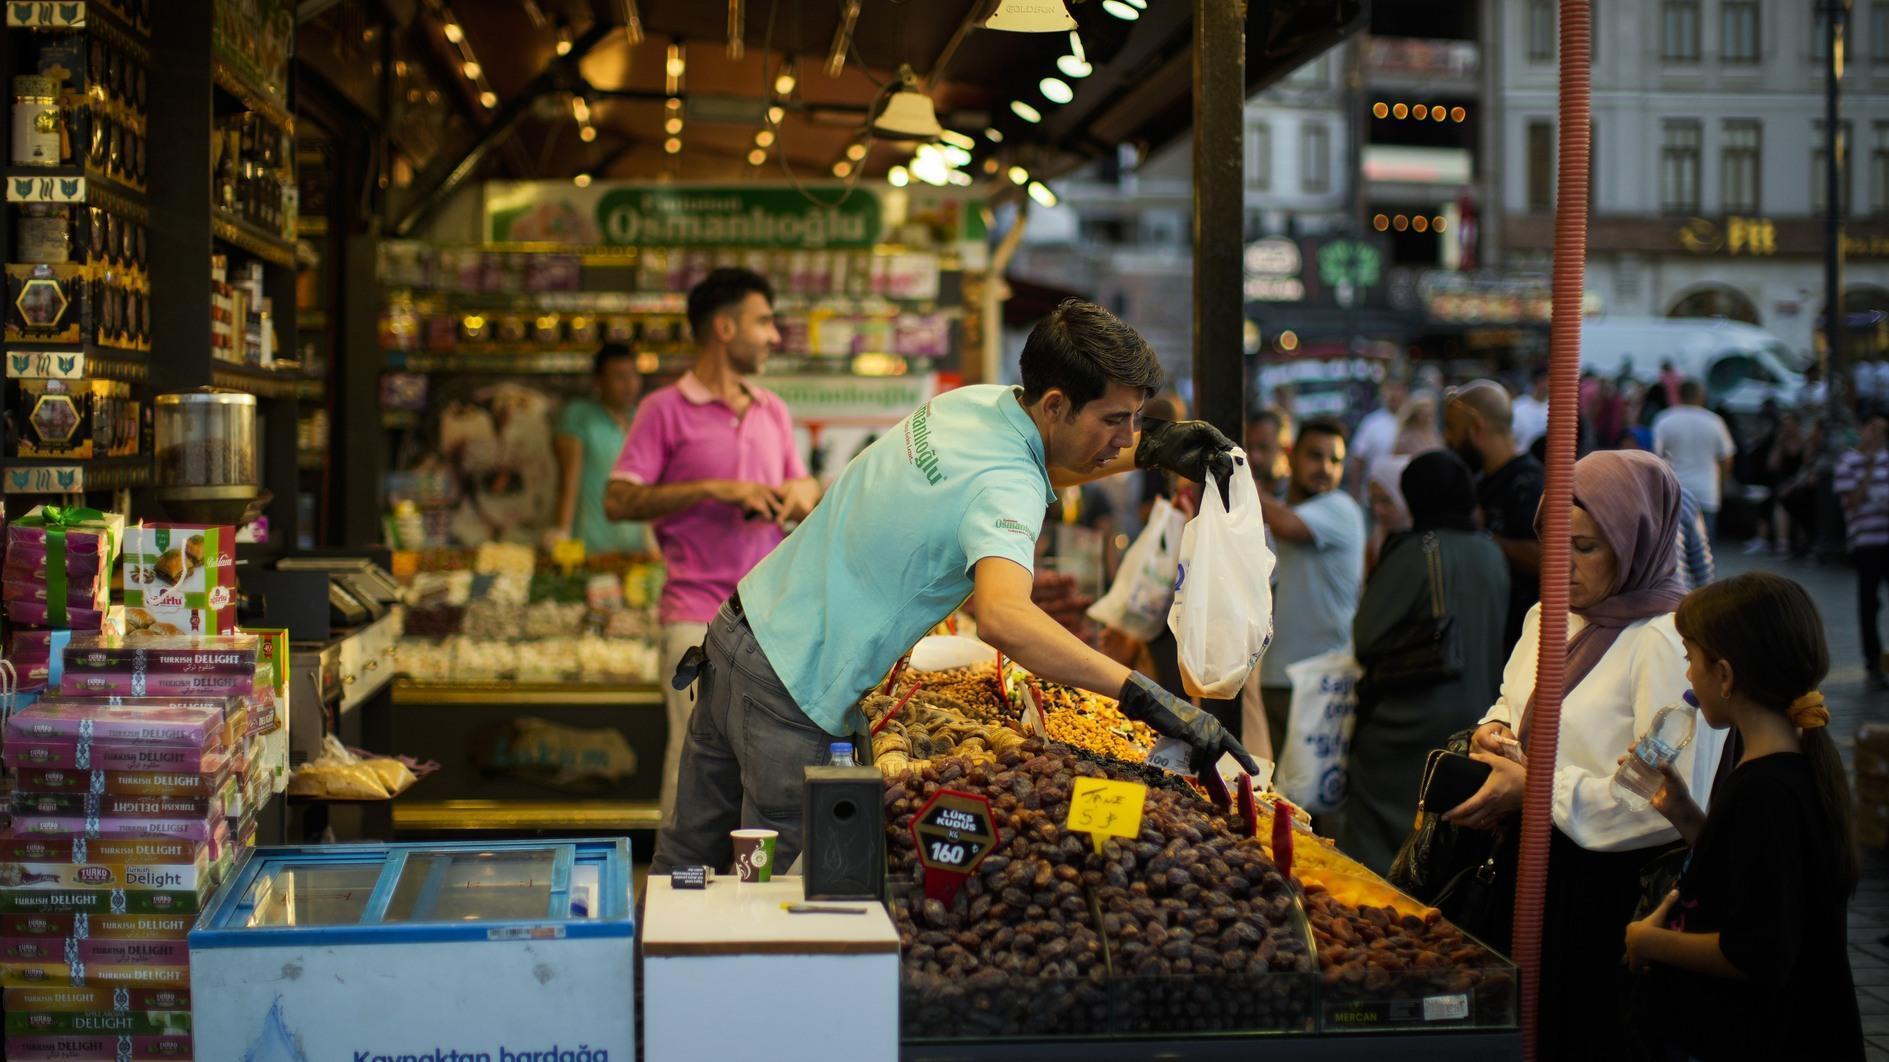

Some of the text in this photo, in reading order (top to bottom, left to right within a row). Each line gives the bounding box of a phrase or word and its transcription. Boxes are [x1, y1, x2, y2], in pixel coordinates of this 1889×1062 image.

[160, 654, 240, 664] TURKISH DELIGHT
[193, 678, 238, 688] DELIGHT
[141, 729, 187, 739] DELIGHT
[138, 752, 185, 763] DELIGHT
[118, 776, 200, 786] TURKISH DELIGHT
[112, 802, 159, 813] DELIGHT
[942, 809, 974, 822] LÜKS
[149, 823, 190, 833] DELIGHT
[100, 846, 182, 856] TURKISH DELIGHT
[931, 842, 965, 864] 160
[126, 872, 182, 888] Delight
[15, 895, 98, 906] TURKISH DELIGHT
[102, 920, 185, 931] TURKISH DELIGHT
[127, 945, 174, 956] DELIGHT
[134, 970, 181, 980] DELIGHT
[55, 993, 95, 1002] DELIGHT
[1334, 1012, 1378, 1023] MERCAN
[75, 1017, 134, 1030] DELIGHT
[57, 1041, 104, 1052] DELIGHT
[499, 1045, 609, 1062] bardağa
